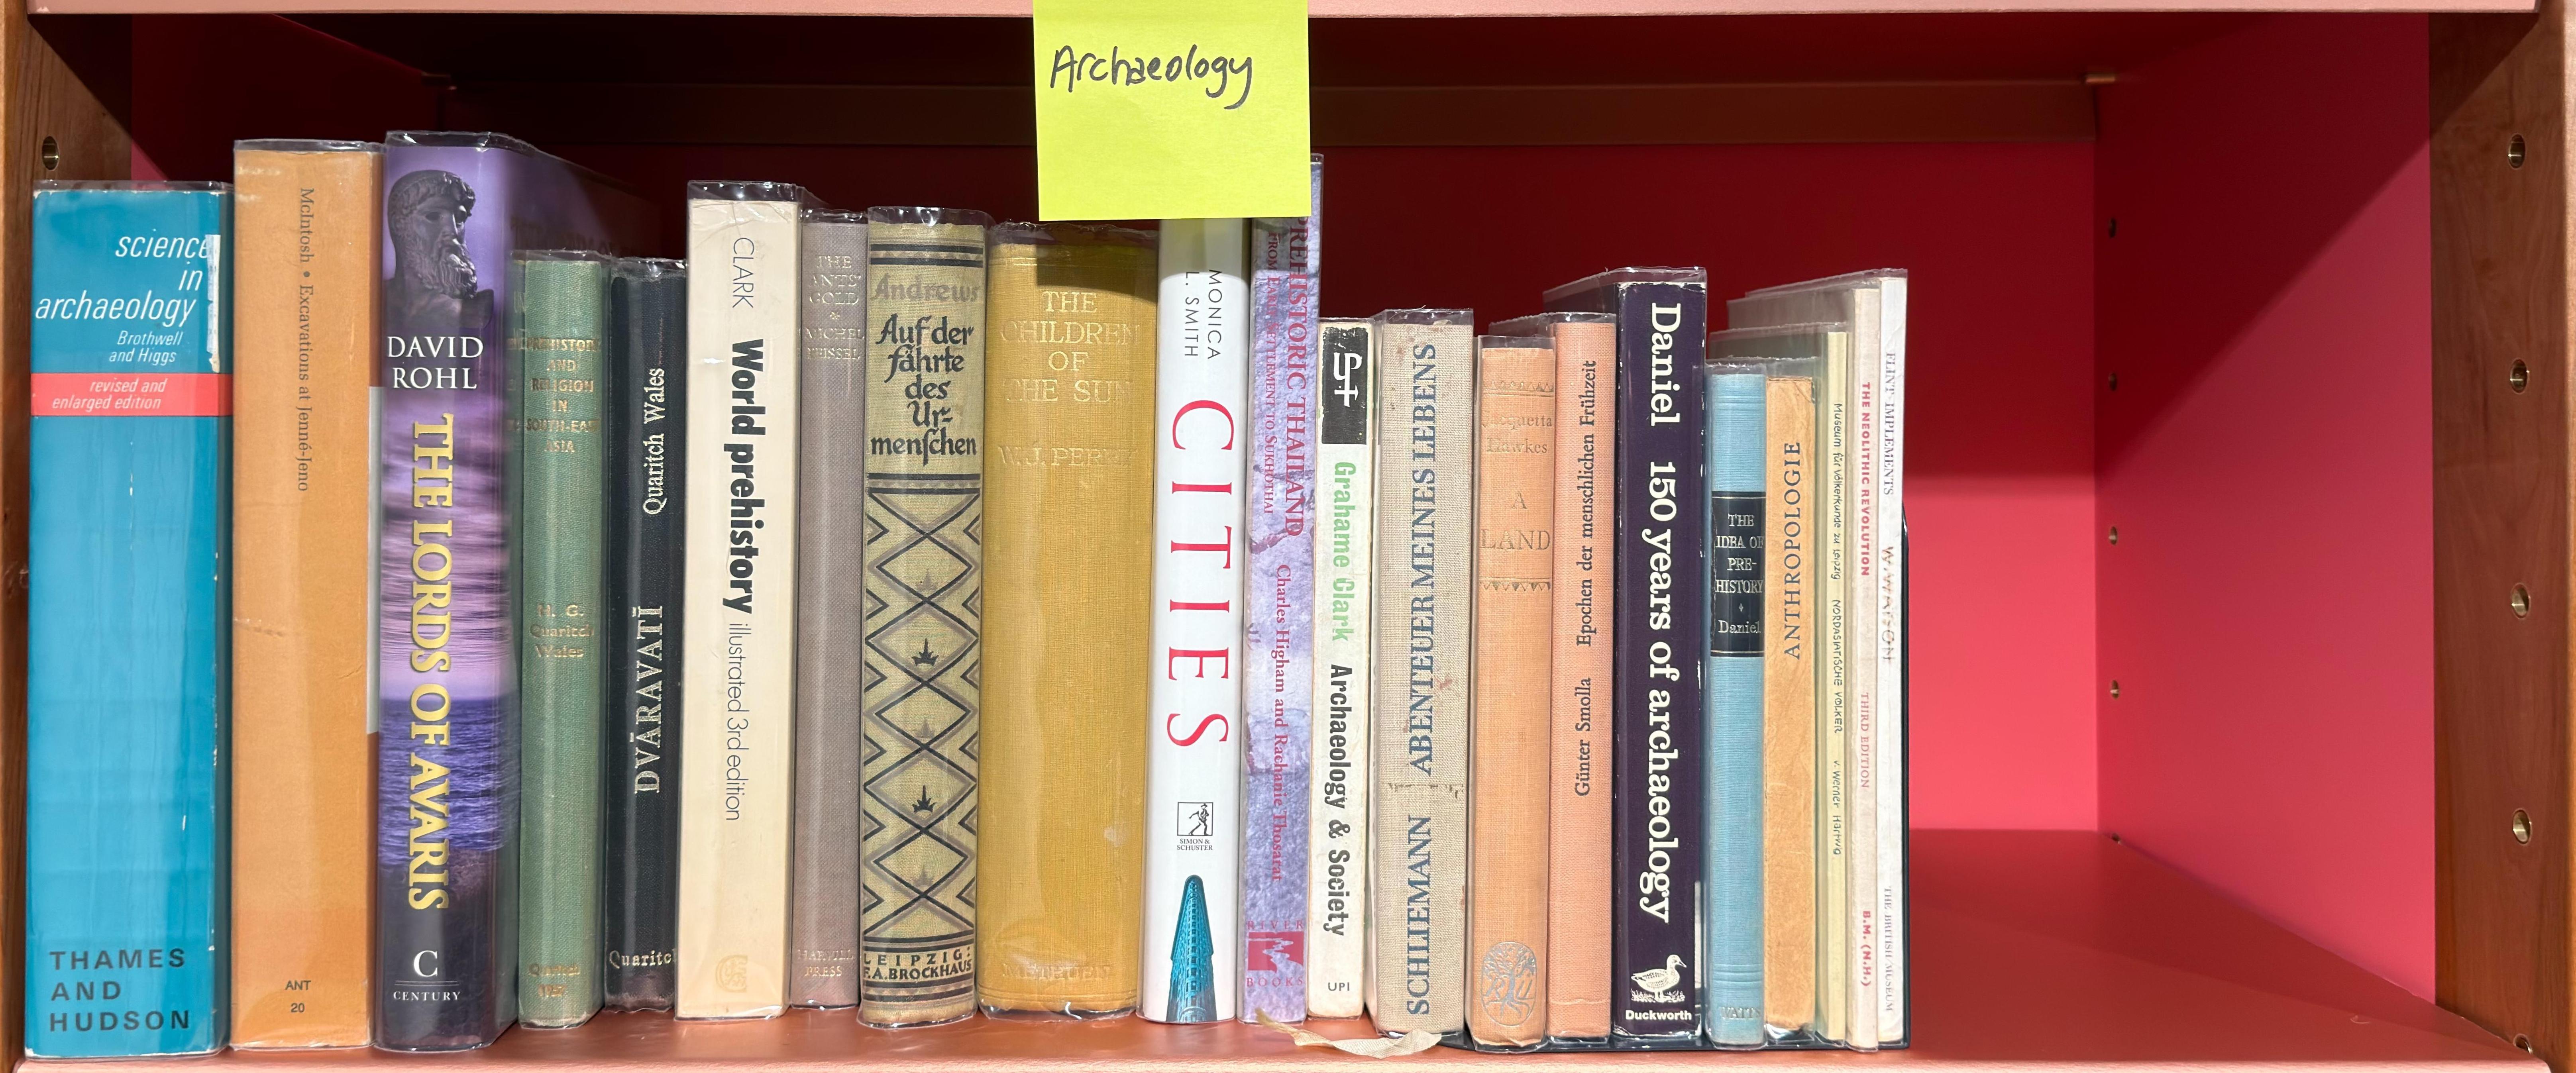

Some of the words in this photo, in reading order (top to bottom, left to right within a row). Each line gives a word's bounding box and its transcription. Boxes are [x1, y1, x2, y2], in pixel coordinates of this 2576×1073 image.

[1050, 45, 1252, 110] Archaeology
[115, 228, 207, 259] science
[299, 188, 315, 263] McIntosh
[817, 256, 851, 268] THE
[1267, 230, 1281, 270] FROM
[179, 261, 202, 291] in
[733, 238, 754, 309] CLARK
[872, 273, 980, 302] Andrews
[1186, 271, 1200, 286] L.
[35, 290, 196, 328] archaeology
[810, 292, 859, 305] GOLD
[1042, 291, 1098, 313] THE
[1208, 269, 1223, 359] MONICA
[117, 330, 183, 346] Brothwell
[298, 284, 314, 381] Excavations
[876, 313, 931, 346] Auf
[931, 316, 974, 345] der
[999, 321, 1140, 345] CHILDREN
[1184, 297, 1199, 356] SMITH
[109, 348, 134, 362] and
[137, 348, 177, 366] Higgs
[387, 336, 483, 358] DAVID
[1048, 351, 1089, 371] OF
[1651, 303, 1681, 426] Daniel
[90, 378, 137, 392] revised
[141, 378, 168, 392] and
[298, 386, 310, 401] at
[392, 367, 477, 389] ROHL
[731, 338, 766, 435] World
[905, 374, 951, 400] des
[1073, 380, 1133, 403] SUN
[1580, 360, 1596, 426] Frühzeit
[1862, 382, 1870, 407] THE
[1885, 353, 1896, 396] FLINT
[52, 396, 111, 412] enlarged
[114, 396, 161, 409] edition
[644, 368, 665, 424] Wales
[1412, 344, 1436, 462] LEBENS
[1264, 415, 1275, 430] TO
[1481, 410, 1552, 430] Jcquetta
[1834, 403, 1842, 447] Museum
[296, 406, 313, 492] Jenné-Jeno
[413, 413, 454, 508] THE
[1486, 438, 1548, 453] Hawkes
[1833, 453, 1844, 467] für
[1861, 412, 1870, 485] NEOLITHIC
[1883, 402, 1895, 495] IMPLEMENTS
[643, 433, 667, 514] Quaritch
[1264, 435, 1277, 514] SUKHOTHAI
[1285, 397, 1306, 536] THAILAND
[1577, 433, 1594, 539] menschlichen
[1511, 491, 1528, 509] A
[1649, 461, 1677, 522] 150
[1833, 470, 1843, 528] Völkerkunde
[723, 443, 765, 614] prehistory
[1333, 462, 1357, 567] Grahame
[1411, 468, 1435, 589] MEINES
[1728, 514, 1754, 527] THE
[1861, 489, 1870, 576] REVOLUTION
[1480, 529, 1550, 549] LAND
[1576, 545, 1593, 572] der
[1716, 536, 1746, 548] IDEA
[1749, 536, 1764, 548] OF
[1784, 441, 1801, 660] ANTHROPOLOGIE
[1834, 533, 1841, 544] zu
[1167, 400, 1234, 747] CITIES
[1641, 529, 1672, 630] years
[1727, 558, 1757, 571] PRE-
[1831, 549, 1841, 580] Leipzig
[410, 520, 453, 674] LORDS
[1276, 565, 1291, 624] Charles
[1715, 579, 1764, 593] HISTORY
[1332, 578, 1355, 641] Clark
[1576, 579, 1597, 647] Epochen
[1718, 620, 1761, 634] Daniel
[728, 623, 752, 712] illustrated
[1271, 630, 1290, 693] Higham
[1649, 642, 1680, 681] of
[1409, 596, 1435, 777] ABENTEUER
[1575, 677, 1591, 732] Smolla
[410, 683, 451, 746] OF
[1274, 699, 1289, 727] and
[1861, 692, 1869, 732] THIRD
[727, 718, 749, 750] 3rd
[1324, 664, 1352, 810] Archaeology
[1273, 732, 1288, 806] Rachanie
[1574, 740, 1591, 797] Günter
[1861, 736, 1869, 788] EDITION
[726, 755, 749, 820] edition
[1639, 689, 1679, 924] archaeology
[1832, 771, 1841, 808] Werner
[408, 752, 450, 911] AVARIS
[1271, 811, 1287, 882] Thosarat
[1329, 819, 1350, 839] &
[1323, 849, 1350, 936] Society
[1247, 920, 1303, 930] RIVER
[1407, 815, 1431, 1015] SCHLIEMANN
[1863, 910, 1871, 940] B.M.
[1884, 914, 1894, 957] BRITISH
[49, 948, 185, 970] THAMES
[414, 950, 438, 977] C
[609, 950, 675, 969] Quaritc
[805, 966, 842, 977] PRESS
[1861, 944, 1871, 987] (N.H.)
[51, 981, 121, 1001] AND
[285, 980, 311, 991] ANT
[393, 990, 461, 1001] CENTURY
[1247, 977, 1303, 987] BOOKS
[1884, 961, 1894, 1011] MUSEUM
[50, 1010, 189, 1032] HUDSON
[291, 1003, 305, 1013] 20
[1626, 1010, 1692, 1020] Duckworth
